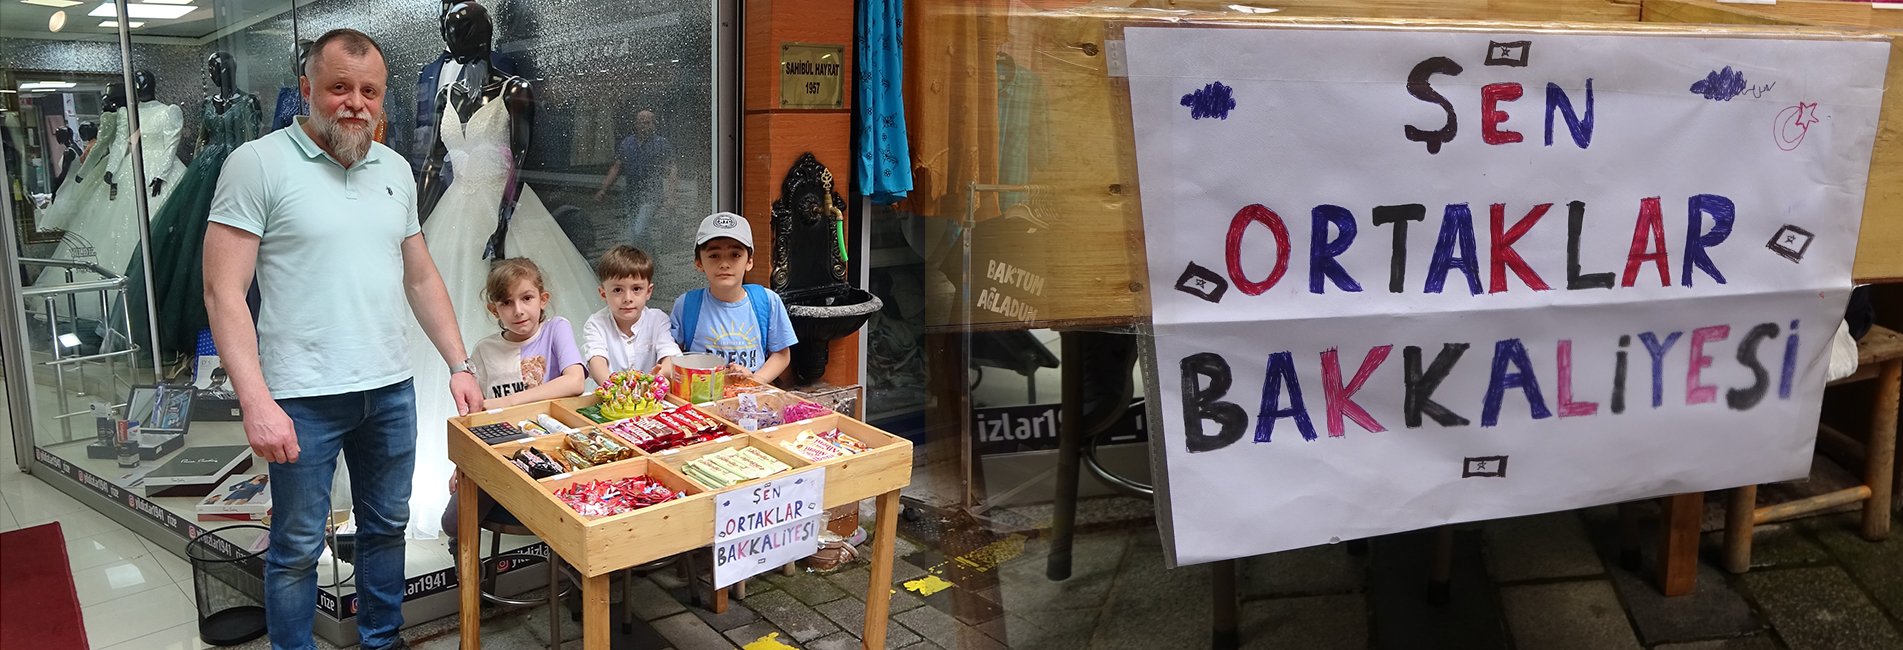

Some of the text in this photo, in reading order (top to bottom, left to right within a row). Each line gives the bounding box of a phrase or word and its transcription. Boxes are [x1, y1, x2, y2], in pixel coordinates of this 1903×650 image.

[815, 63, 839, 76] HAYRAT
[1404, 56, 1595, 154] ŞEN
[1224, 193, 1735, 296] ORTAKLAR
[987, 259, 1045, 297] BAKTUM
[976, 286, 1039, 327] AĞLADUM
[753, 485, 781, 505] ŞEN
[726, 500, 803, 536] ORTAKLAR
